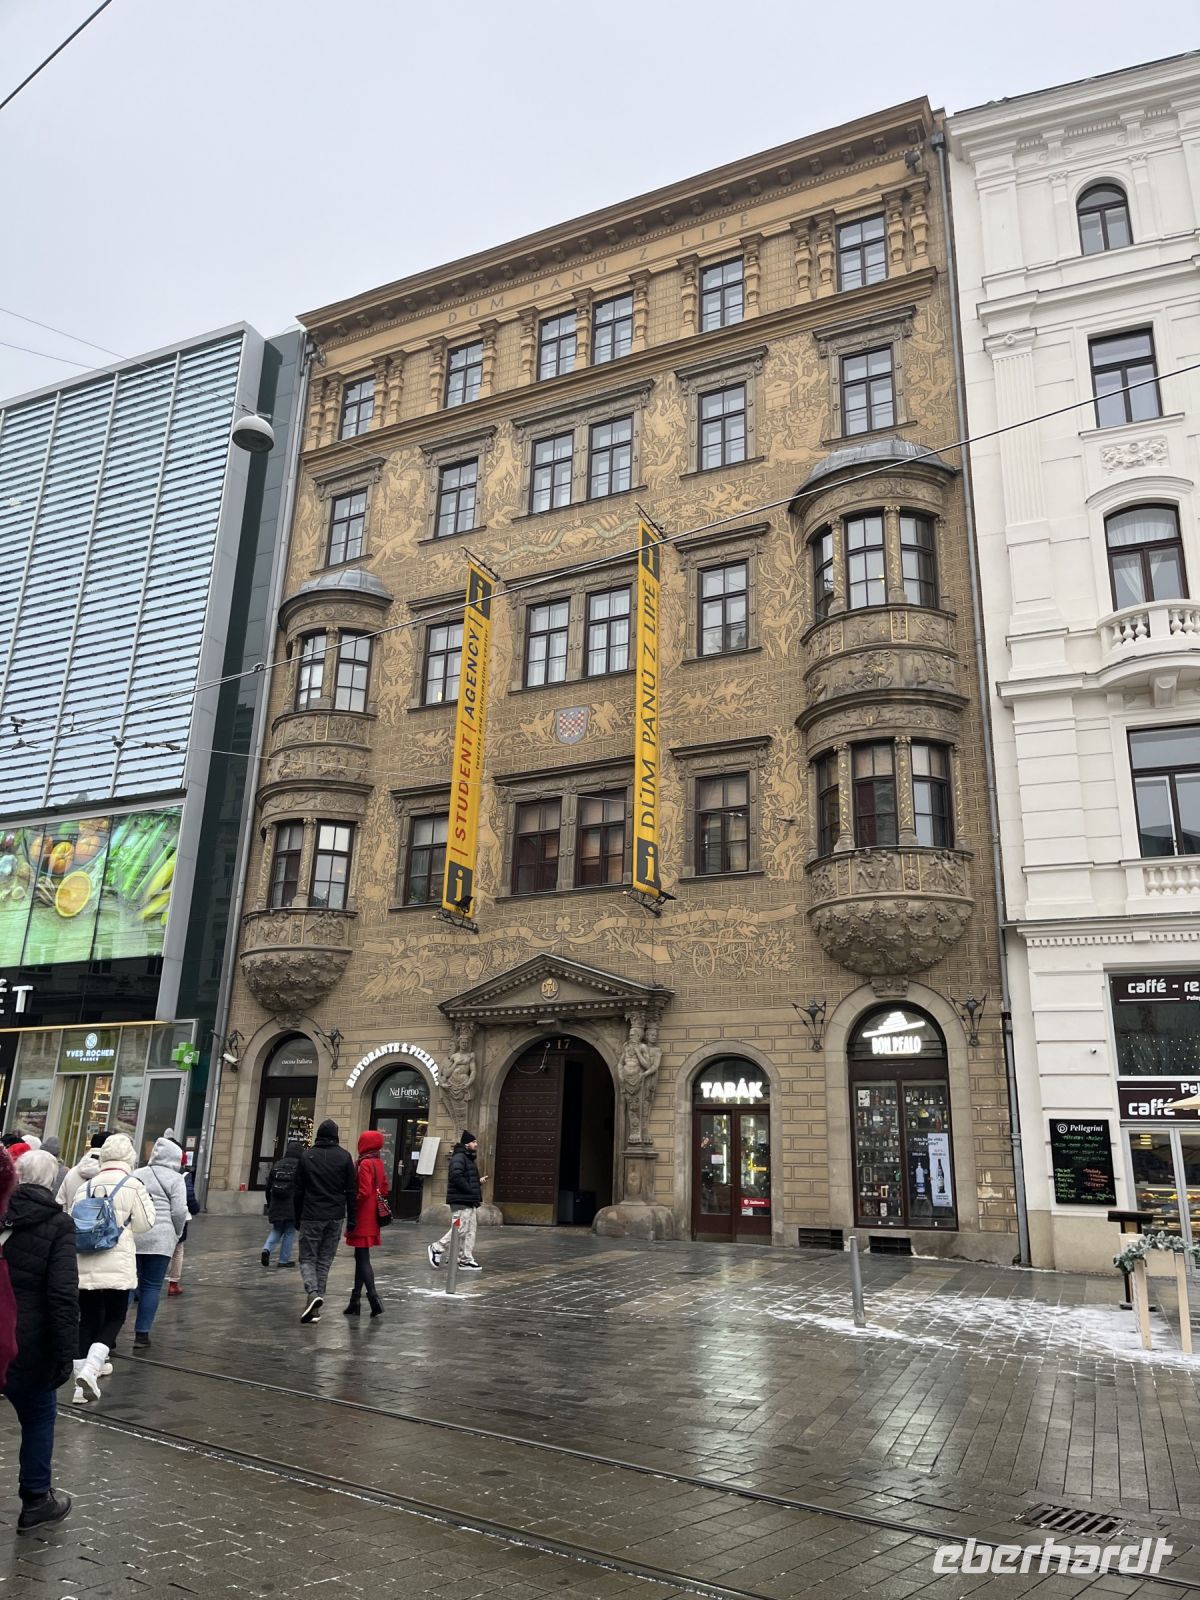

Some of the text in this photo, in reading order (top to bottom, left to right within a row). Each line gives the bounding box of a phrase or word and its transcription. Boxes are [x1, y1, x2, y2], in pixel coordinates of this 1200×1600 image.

[448, 296, 504, 324] DŮM
[639, 249, 648, 260] Z
[642, 579, 656, 635] LIPÉ
[643, 641, 656, 662] Z
[455, 629, 483, 842] STUDENT AGENCY
[639, 758, 656, 830] DŮM
[1127, 978, 1167, 993] caffé
[66, 1049, 115, 1058] YVES ROCHER
[346, 1042, 401, 1089] RISTORANTE
[401, 1042, 409, 1053] &
[700, 1078, 763, 1098] TABÁK
[1070, 1124, 1103, 1133] Pellegrini
